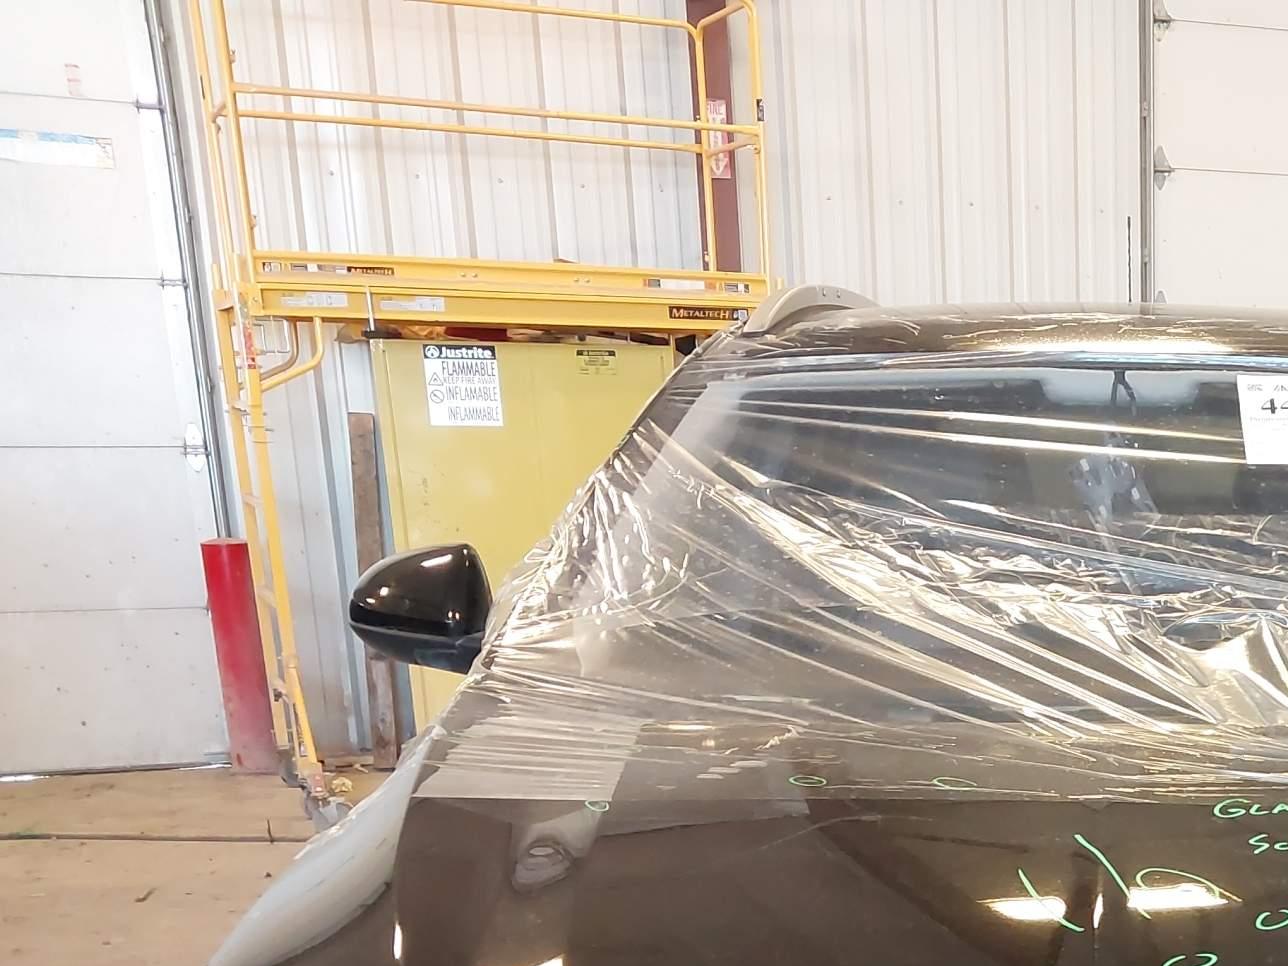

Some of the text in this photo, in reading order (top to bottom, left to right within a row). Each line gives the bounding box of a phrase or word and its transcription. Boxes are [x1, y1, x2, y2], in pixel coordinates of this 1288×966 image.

[440, 346, 492, 359] Justrite
[441, 361, 496, 377] FLAMMABLE
[445, 385, 498, 402] INFLAMABLE
